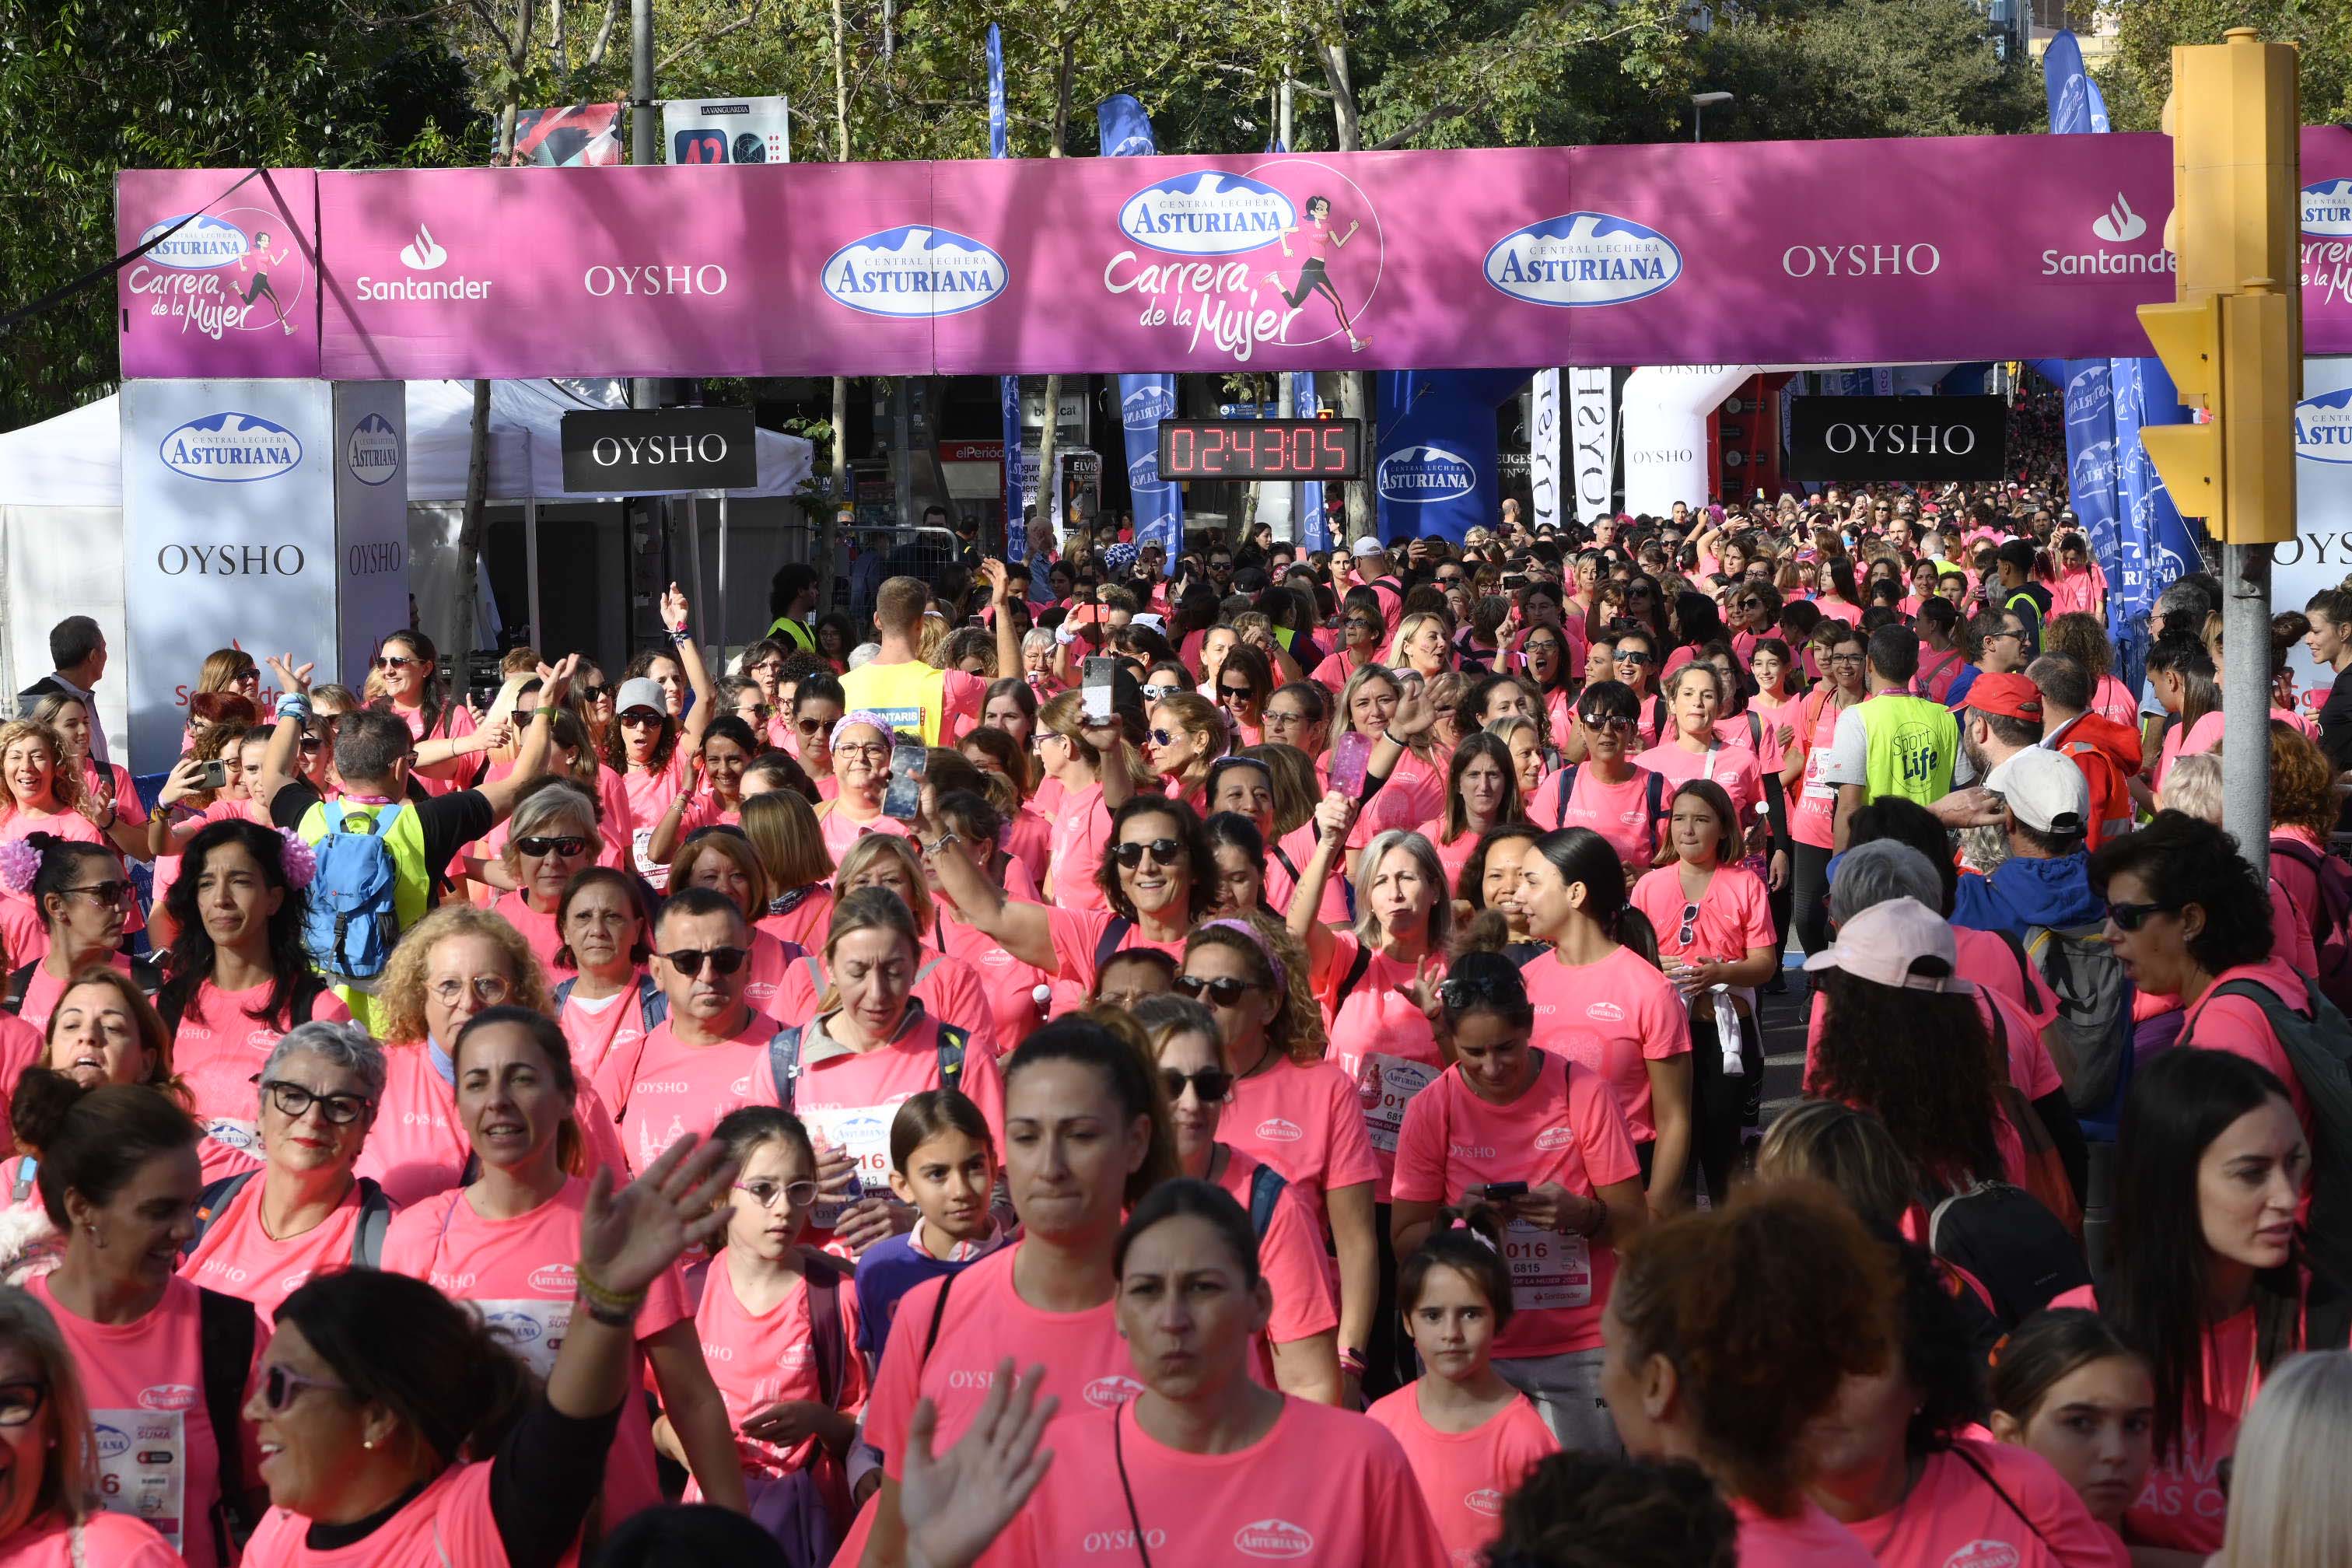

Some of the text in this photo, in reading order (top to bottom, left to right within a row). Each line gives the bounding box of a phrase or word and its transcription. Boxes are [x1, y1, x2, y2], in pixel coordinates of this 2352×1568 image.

[1160, 199, 1277, 209] CENTRAL LECHERA
[2301, 207, 2351, 222] STUR
[1132, 202, 1281, 234] ASTURIANA
[147, 234, 240, 255] ASTURIANA
[1530, 243, 1660, 255] CENTRAL LECHERA
[864, 257, 923, 266] CENTRAL
[1104, 250, 1250, 294] Carrera
[1498, 248, 1668, 283] ASTURIANA
[1783, 243, 1940, 278] OYSHO
[128, 265, 220, 294] Carrera
[357, 275, 492, 300] Santander
[585, 264, 728, 296] OYSHO
[836, 260, 993, 293] ASTURIANA
[2315, 264, 2329, 286] la
[151, 292, 254, 340] de la Mujer
[1139, 291, 1304, 362] de la Mujer
[171, 439, 292, 465] ASTURIANA
[593, 433, 727, 467] OYSHO
[1172, 429, 1345, 471] 02:43:05
[1825, 423, 1976, 456] OYSHO
[352, 440, 397, 467] ASTURIANA
[1073, 461, 1097, 471] ELVIS
[1633, 449, 1692, 464] OYSHO
[1381, 469, 1469, 490] ASTURIANA
[157, 544, 305, 576] OYSHO
[350, 541, 401, 576] OYSHO
[1893, 728, 1932, 756] Sport
[1902, 747, 1937, 781] Life
[636, 1081, 688, 1094] OYSHO
[1506, 1242, 1548, 1258] 016
[1514, 1263, 1541, 1273] 6815
[1543, 1292, 1581, 1301] Santander
[1241, 1531, 1307, 1550] ASTURIANA
